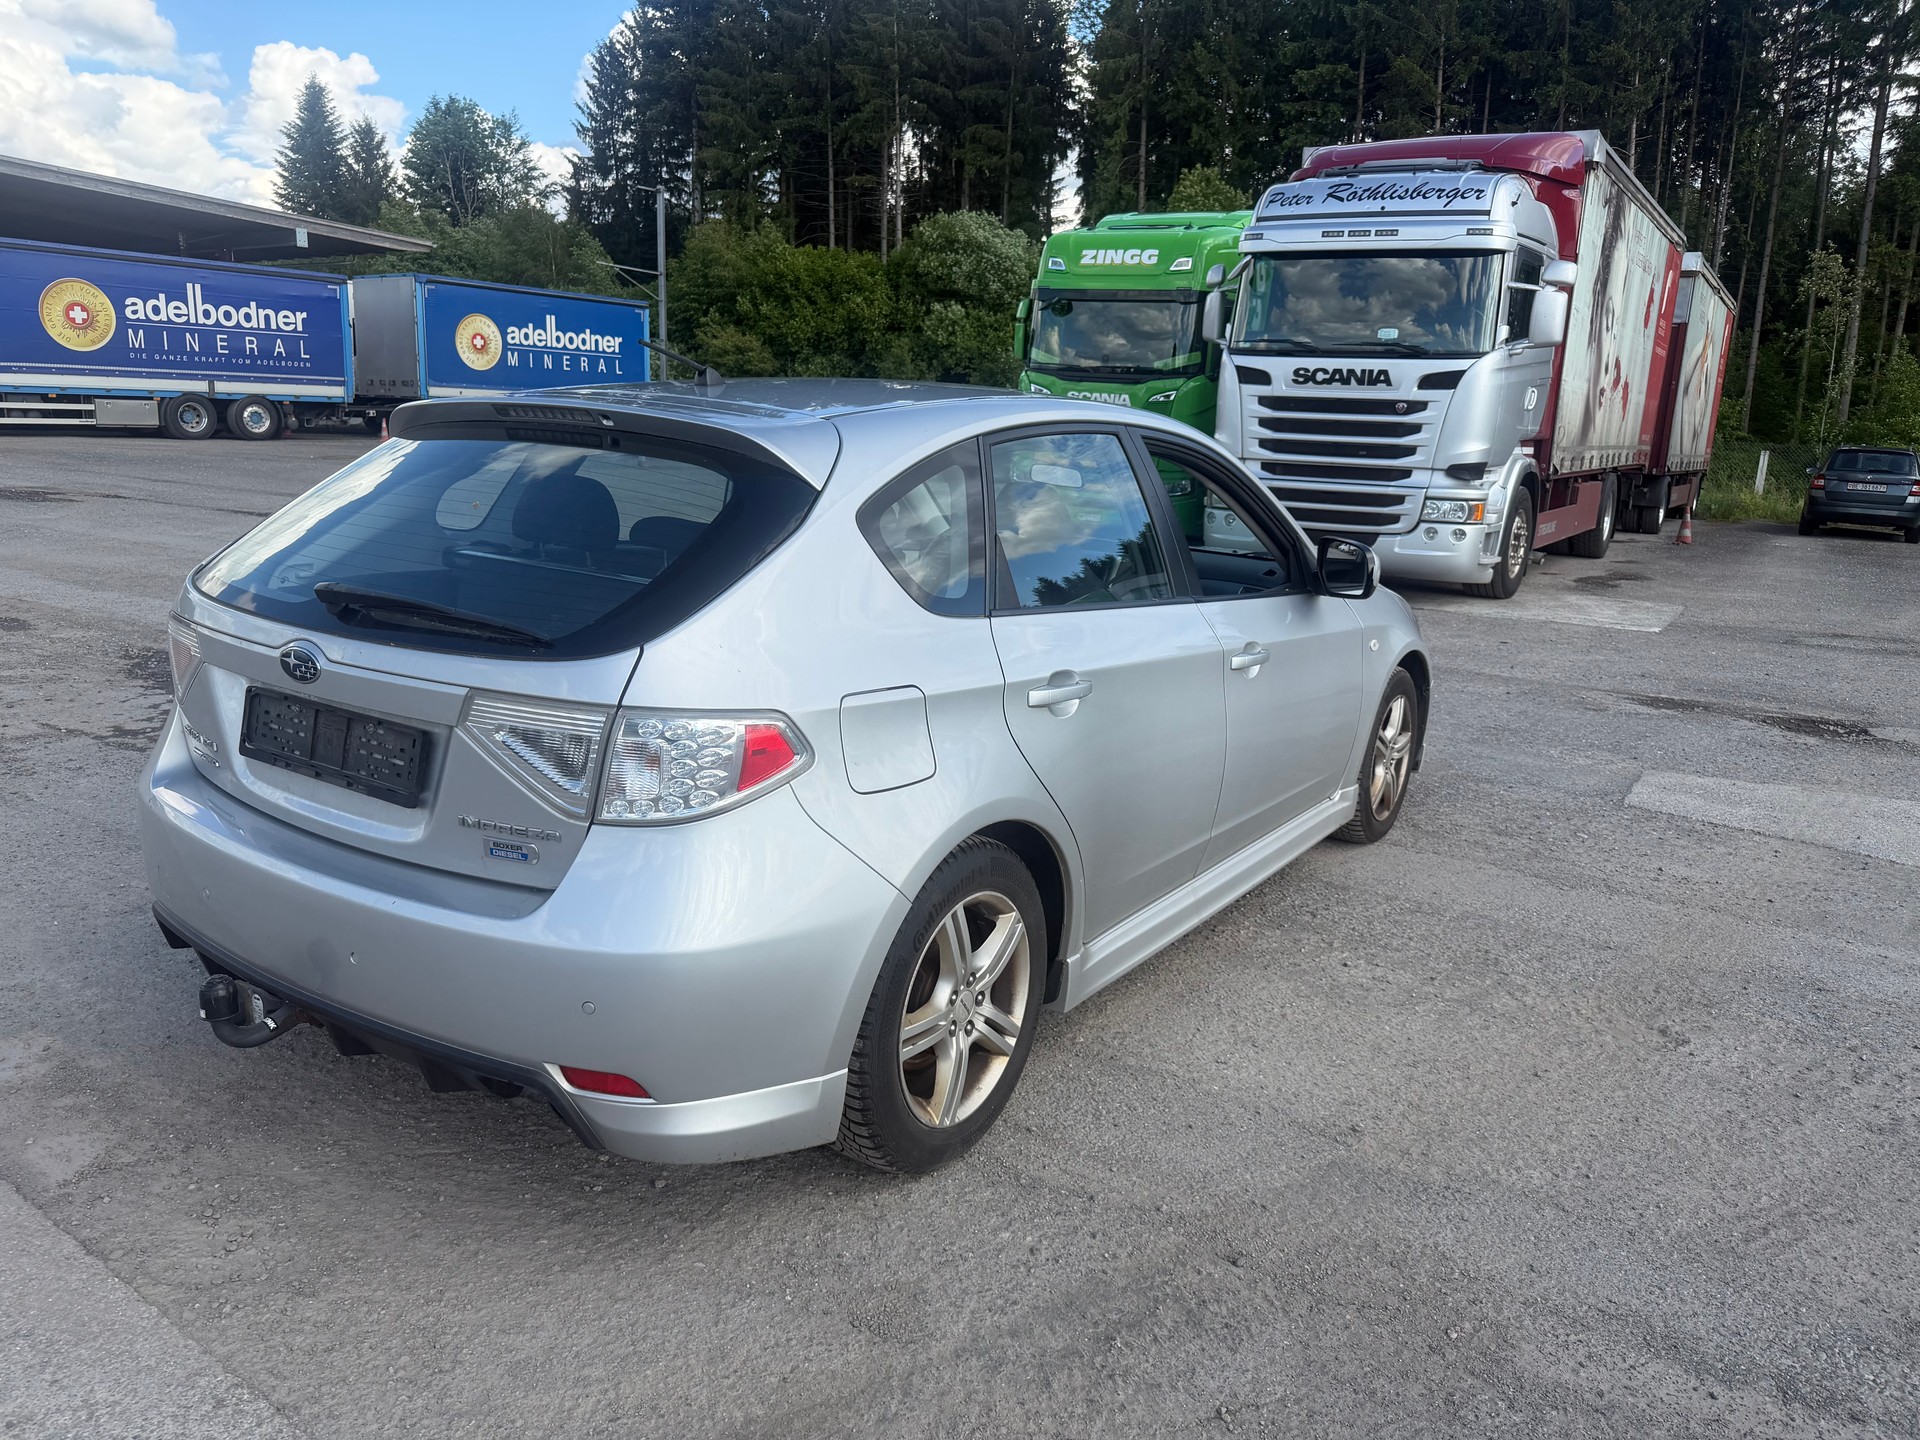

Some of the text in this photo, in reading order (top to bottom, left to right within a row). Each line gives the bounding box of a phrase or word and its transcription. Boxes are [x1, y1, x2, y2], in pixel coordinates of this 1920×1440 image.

[1265, 181, 1487, 209] Peter Röthlisberger
[1079, 248, 1160, 265] ZINGG
[79, 285, 99, 300] VOM
[124, 282, 308, 332] adelbodner
[127, 328, 311, 359] MINERAL
[506, 314, 623, 353] adelbodner
[129, 352, 312, 368] DIE GANZE KRAFT VOM ADELBODEN
[507, 350, 623, 375] MINERAL
[1291, 367, 1393, 387] SCANIA
[458, 814, 562, 842] IMPREZA
[492, 841, 523, 852] BOXER
[492, 848, 526, 860] DIESEL
